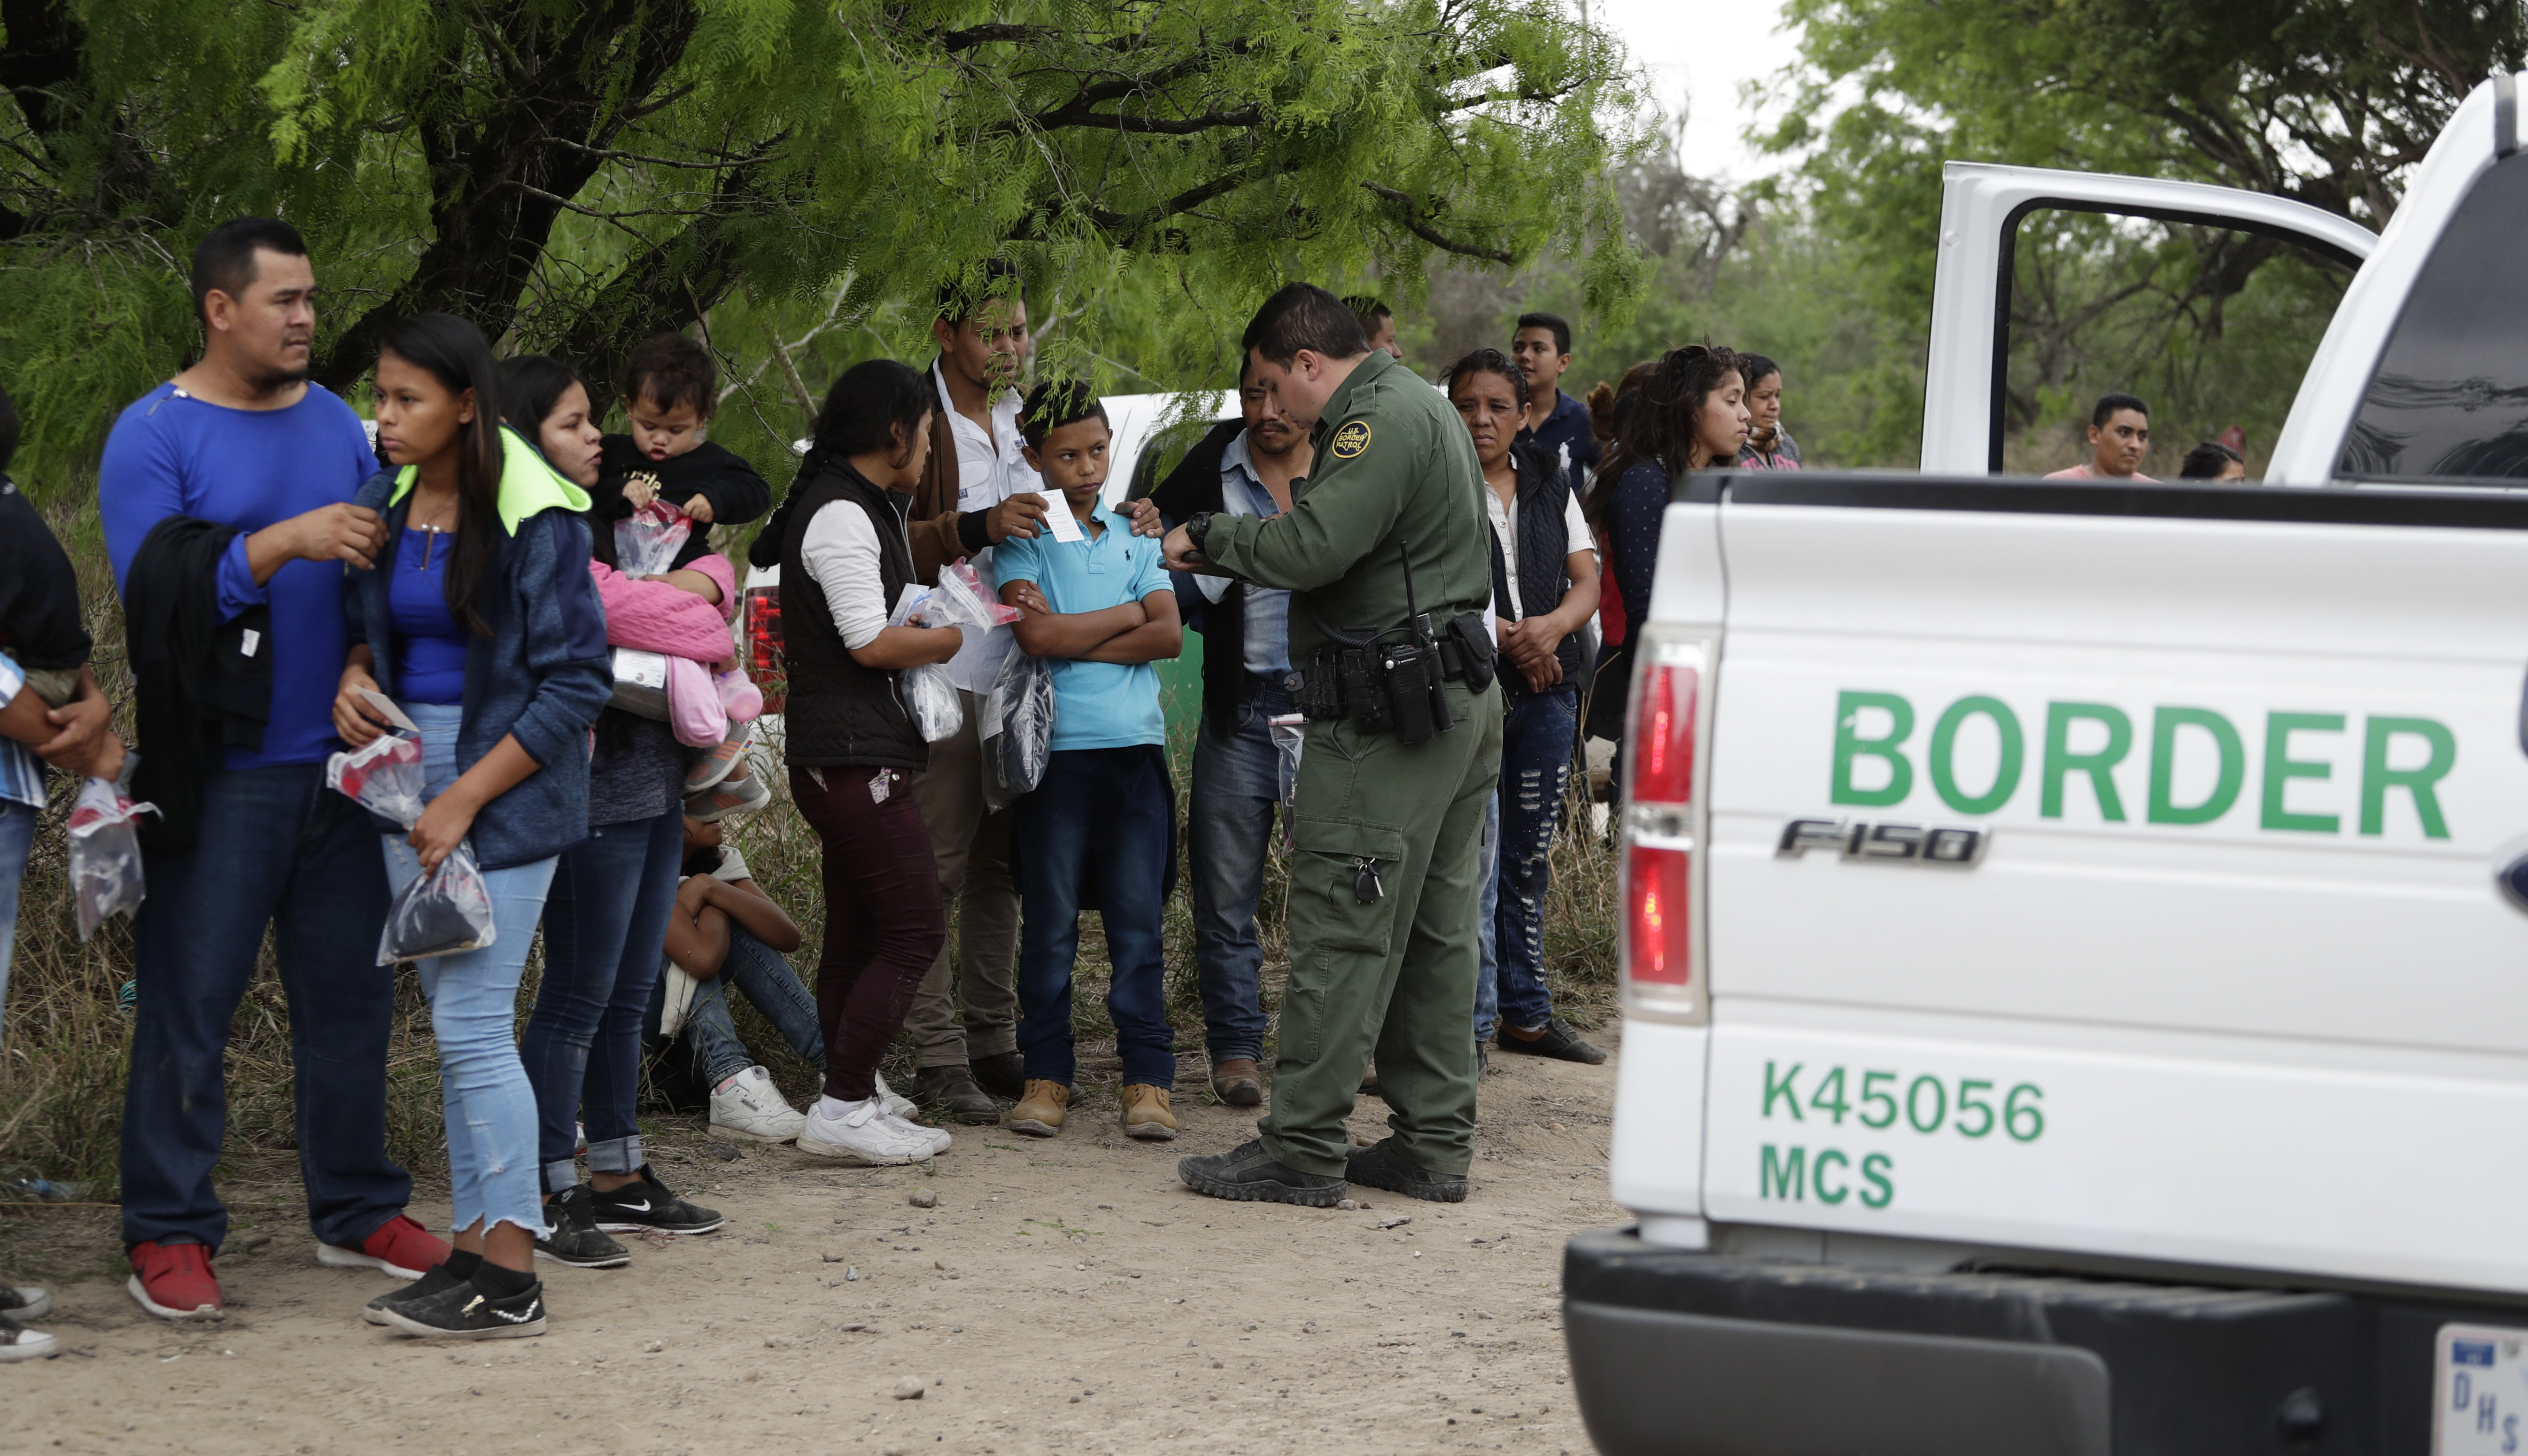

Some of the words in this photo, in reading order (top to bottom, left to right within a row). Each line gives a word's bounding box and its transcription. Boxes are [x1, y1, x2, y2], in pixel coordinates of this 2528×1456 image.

[1830, 689, 2457, 839] BORDER
[1763, 1061, 2044, 1142] K45056
[1761, 1145, 1893, 1209] MCS
